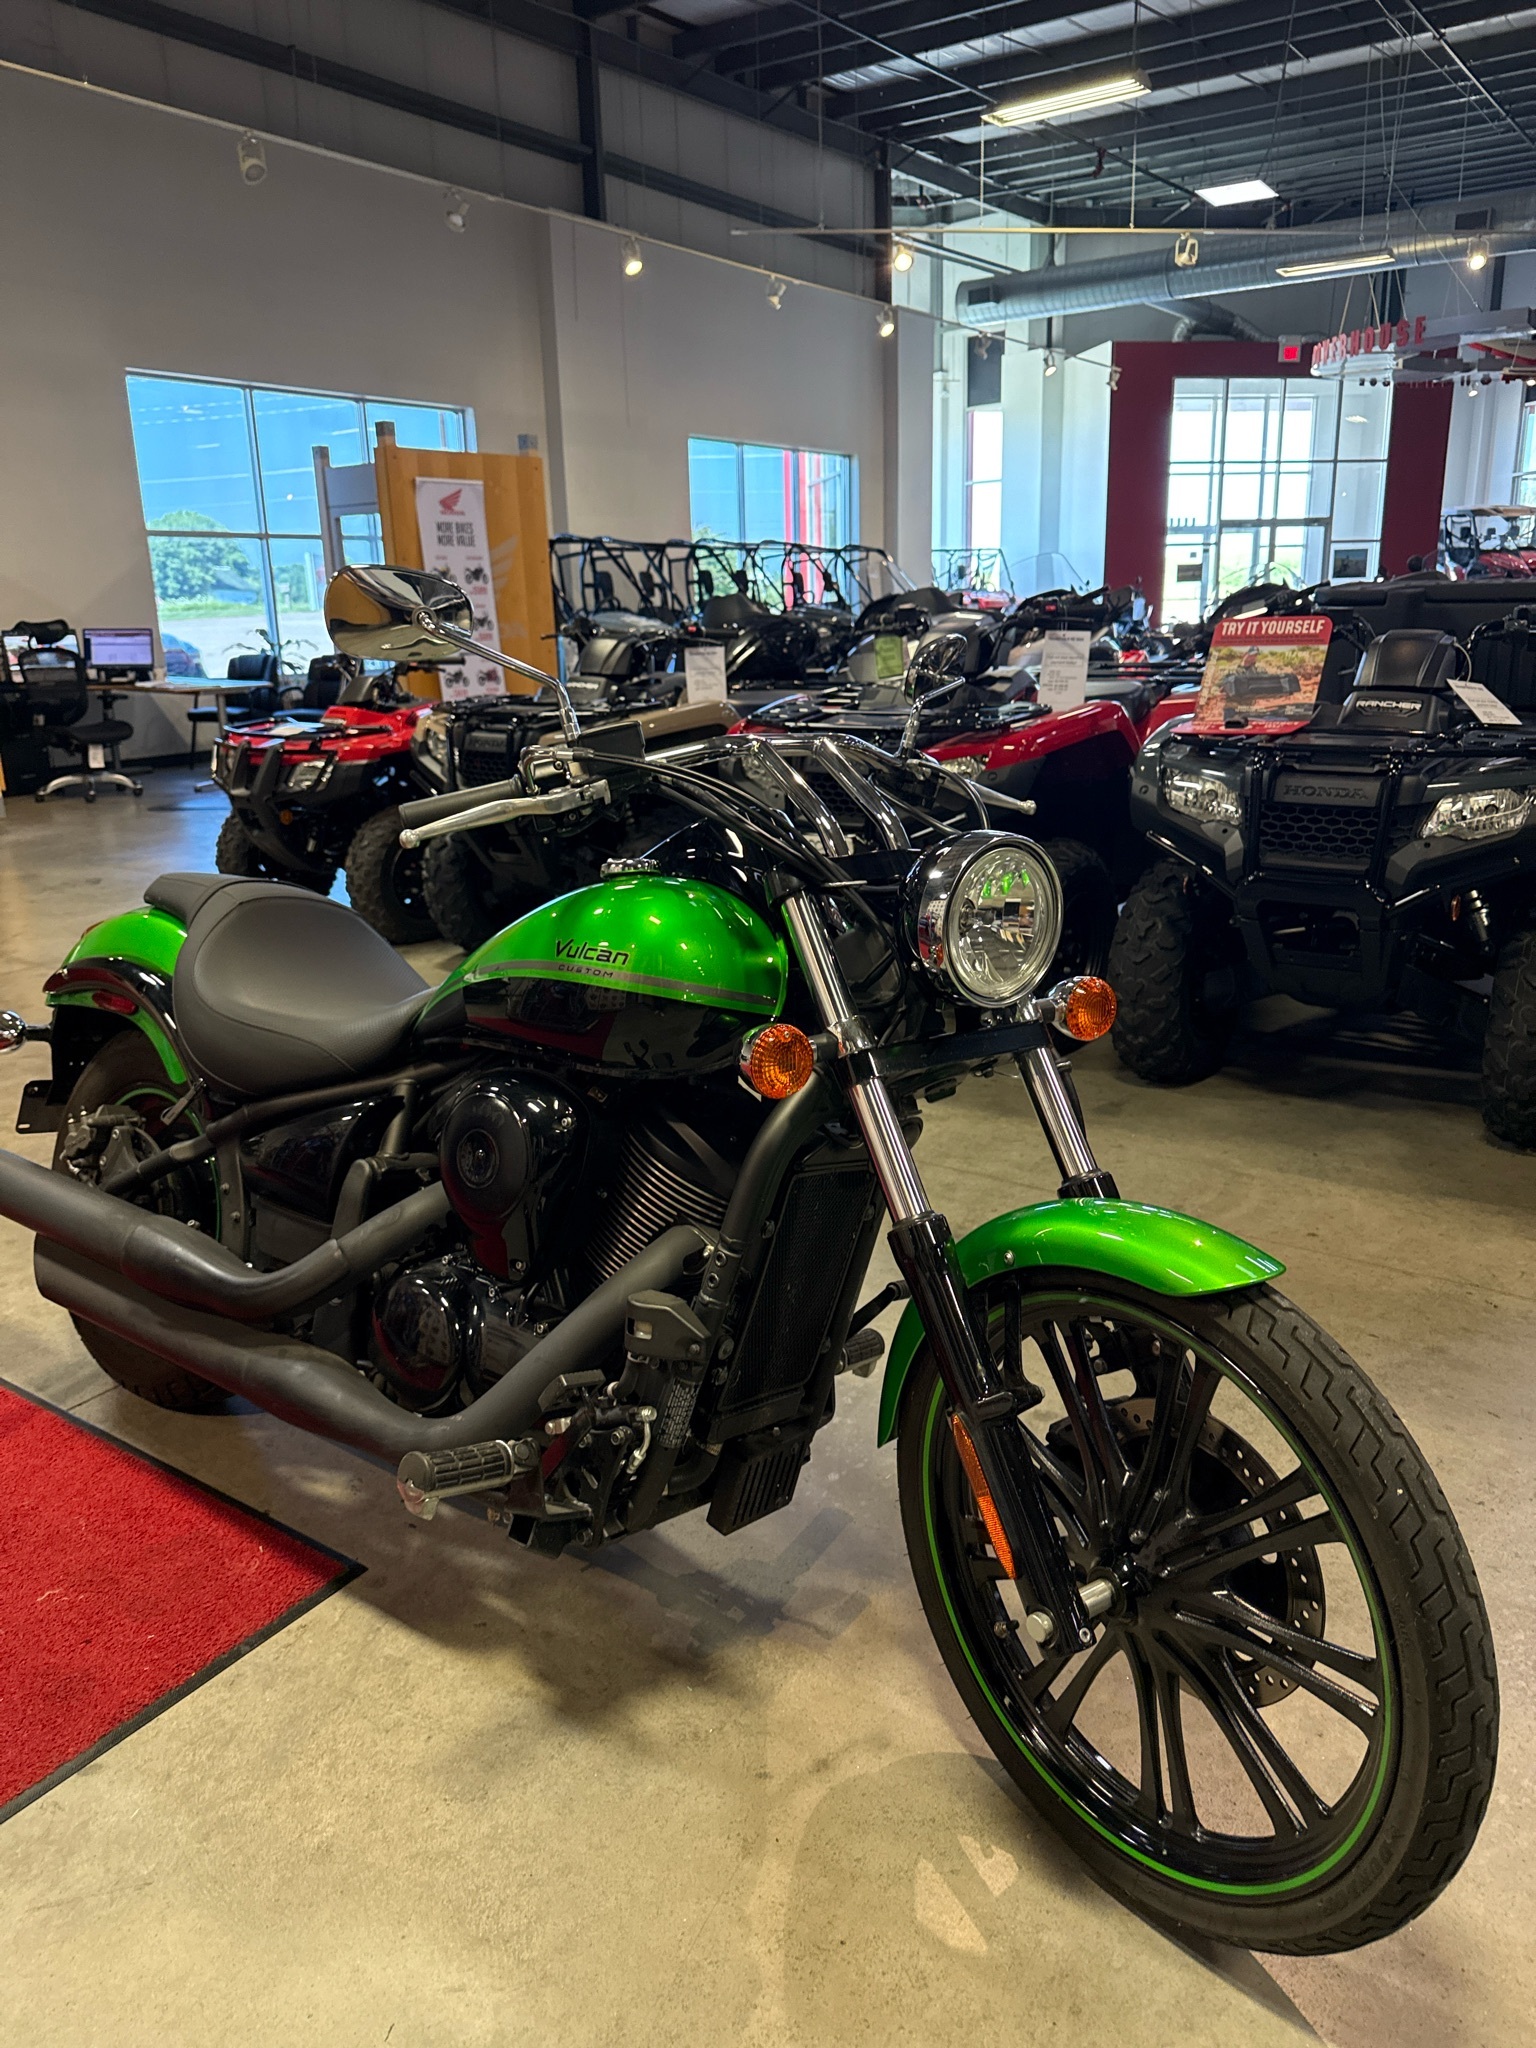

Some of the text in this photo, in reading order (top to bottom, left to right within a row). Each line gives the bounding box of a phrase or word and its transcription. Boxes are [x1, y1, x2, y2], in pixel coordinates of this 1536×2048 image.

[436, 521, 474, 534] MORE BIKES
[437, 534, 476, 547] MORE VALUE
[1221, 619, 1326, 636] TRY IT YOURSELF
[1355, 700, 1422, 711] RANCHER
[1283, 784, 1369, 800] HONDA
[555, 938, 630, 966] Vulcan
[558, 964, 614, 979] CUSTOM
